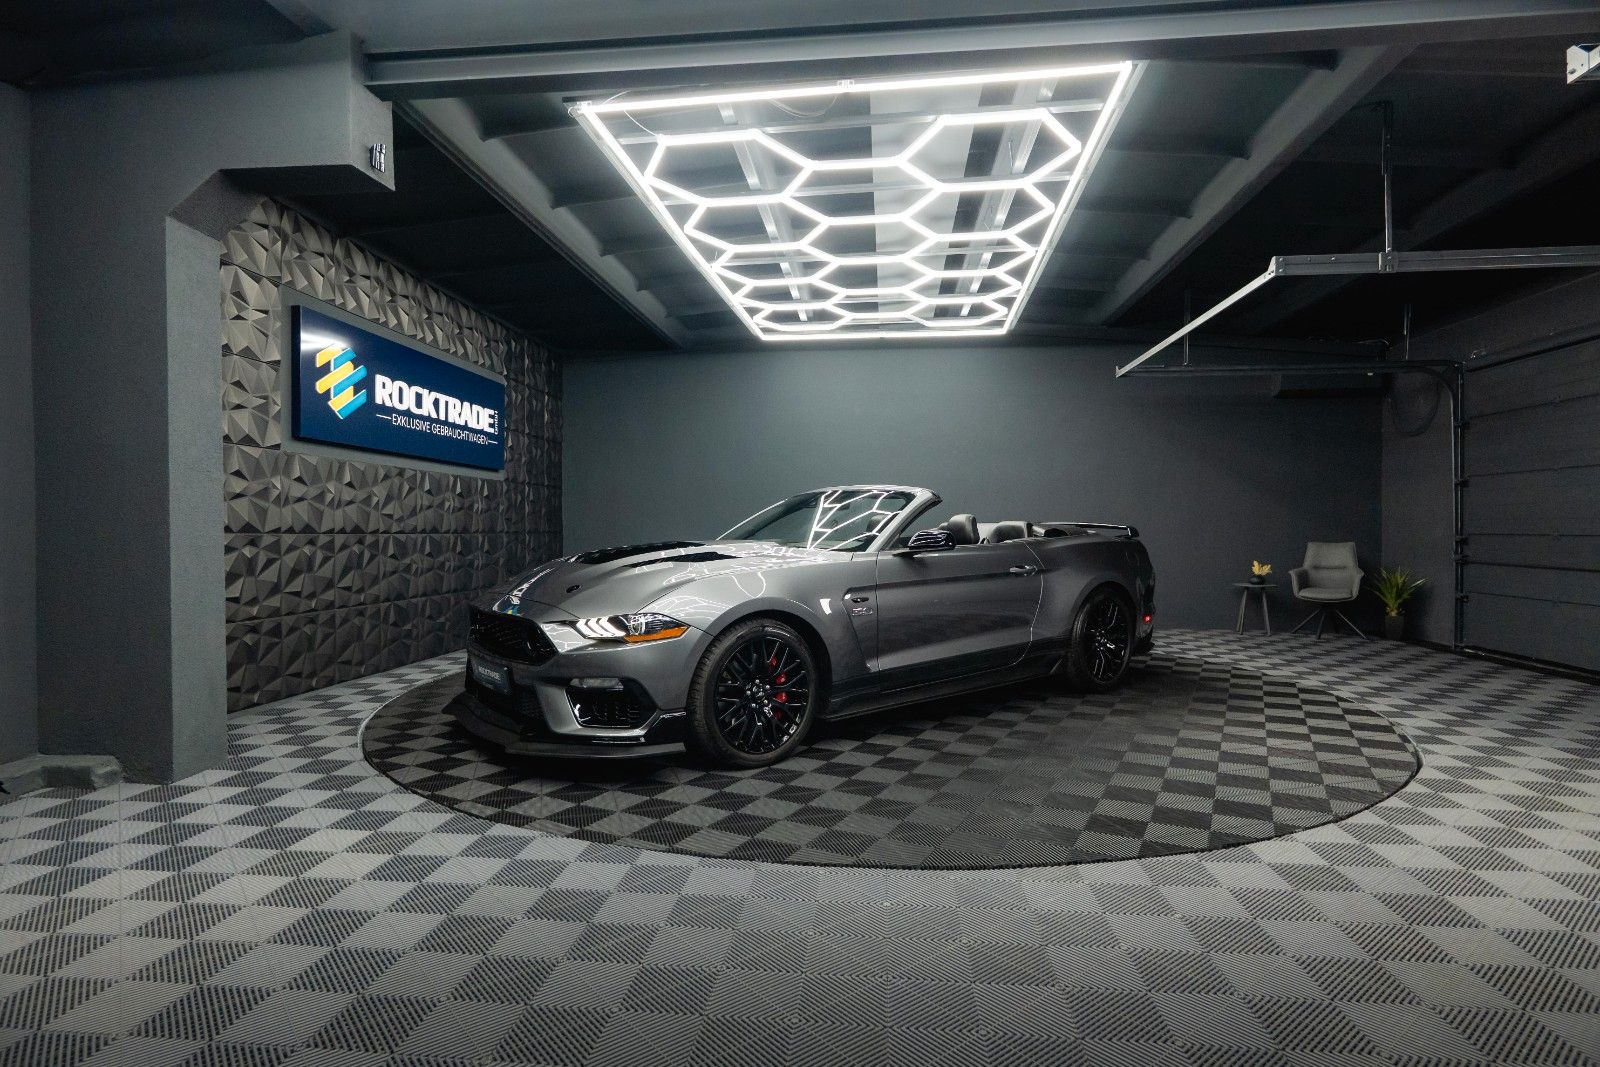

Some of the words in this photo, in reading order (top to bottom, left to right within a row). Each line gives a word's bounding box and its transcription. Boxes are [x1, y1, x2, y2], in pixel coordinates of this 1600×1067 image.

[375, 374, 495, 434] ROCKTRADE
[392, 413, 431, 433] EXKLUSIVE
[431, 423, 489, 445] GEBRAUCHTWAGEN
